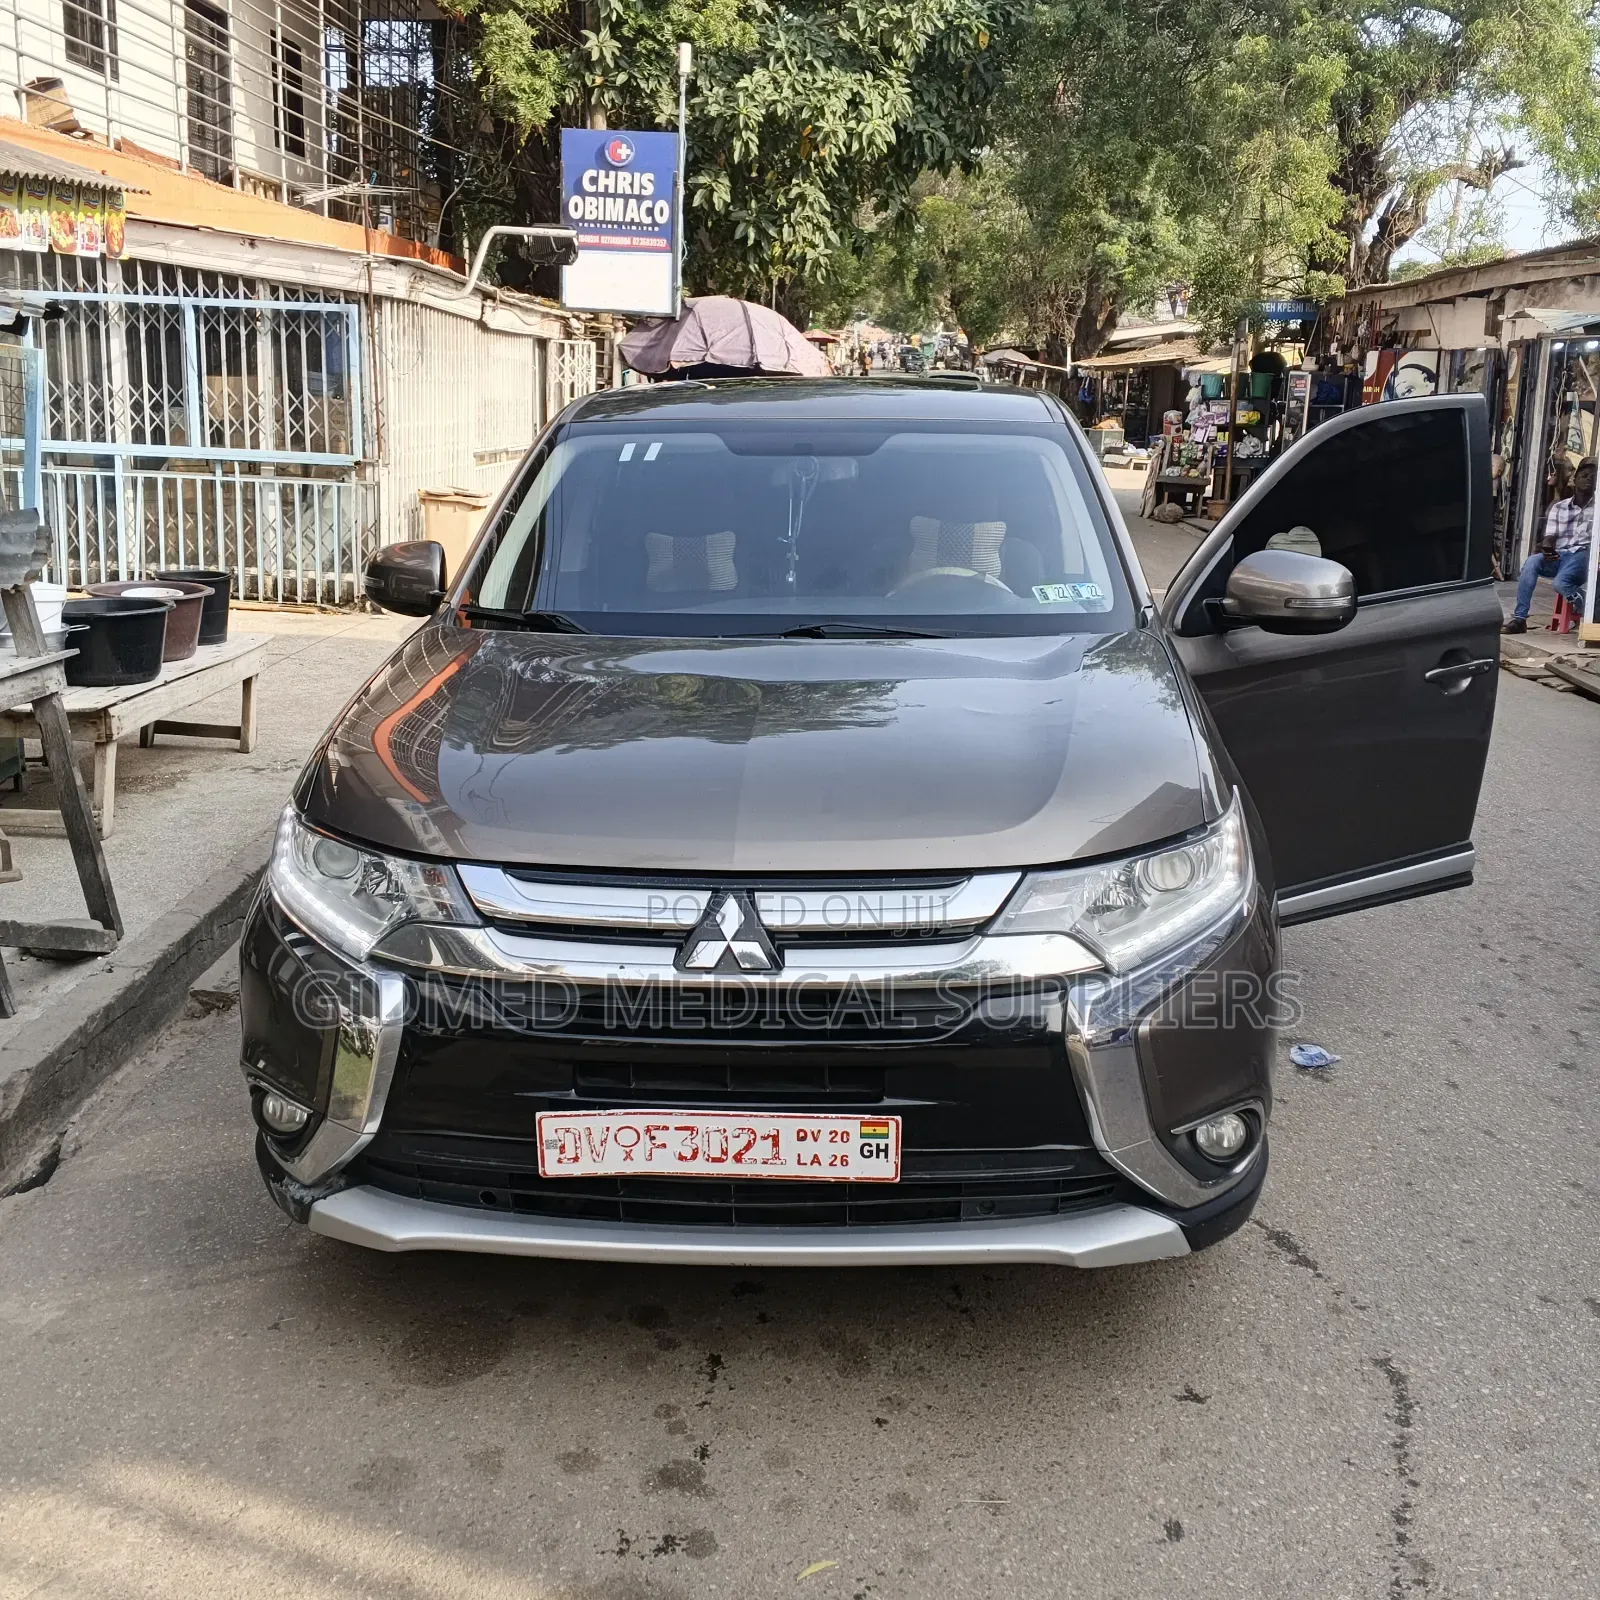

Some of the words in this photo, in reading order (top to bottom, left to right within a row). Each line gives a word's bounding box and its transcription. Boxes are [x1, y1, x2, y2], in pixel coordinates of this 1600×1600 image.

[27, 179, 45, 192] ONGA
[582, 169, 655, 196] CHRIS
[55, 184, 73, 197] ONGA
[83, 190, 99, 202] ONGA
[107, 193, 123, 207] ONGA
[568, 195, 670, 225] OBIMACO
[621, 224, 660, 232] LIMITED
[1277, 302, 1304, 313] KPESHI
[1040, 587, 1050, 601] 5
[1053, 586, 1068, 599] 22
[1071, 585, 1083, 599] 5
[1086, 585, 1101, 597] 22
[796, 1128, 822, 1143] DV
[828, 1129, 851, 1144] 20
[859, 1142, 889, 1160] GH
[796, 1153, 822, 1167] LA
[828, 1153, 850, 1167] 26
